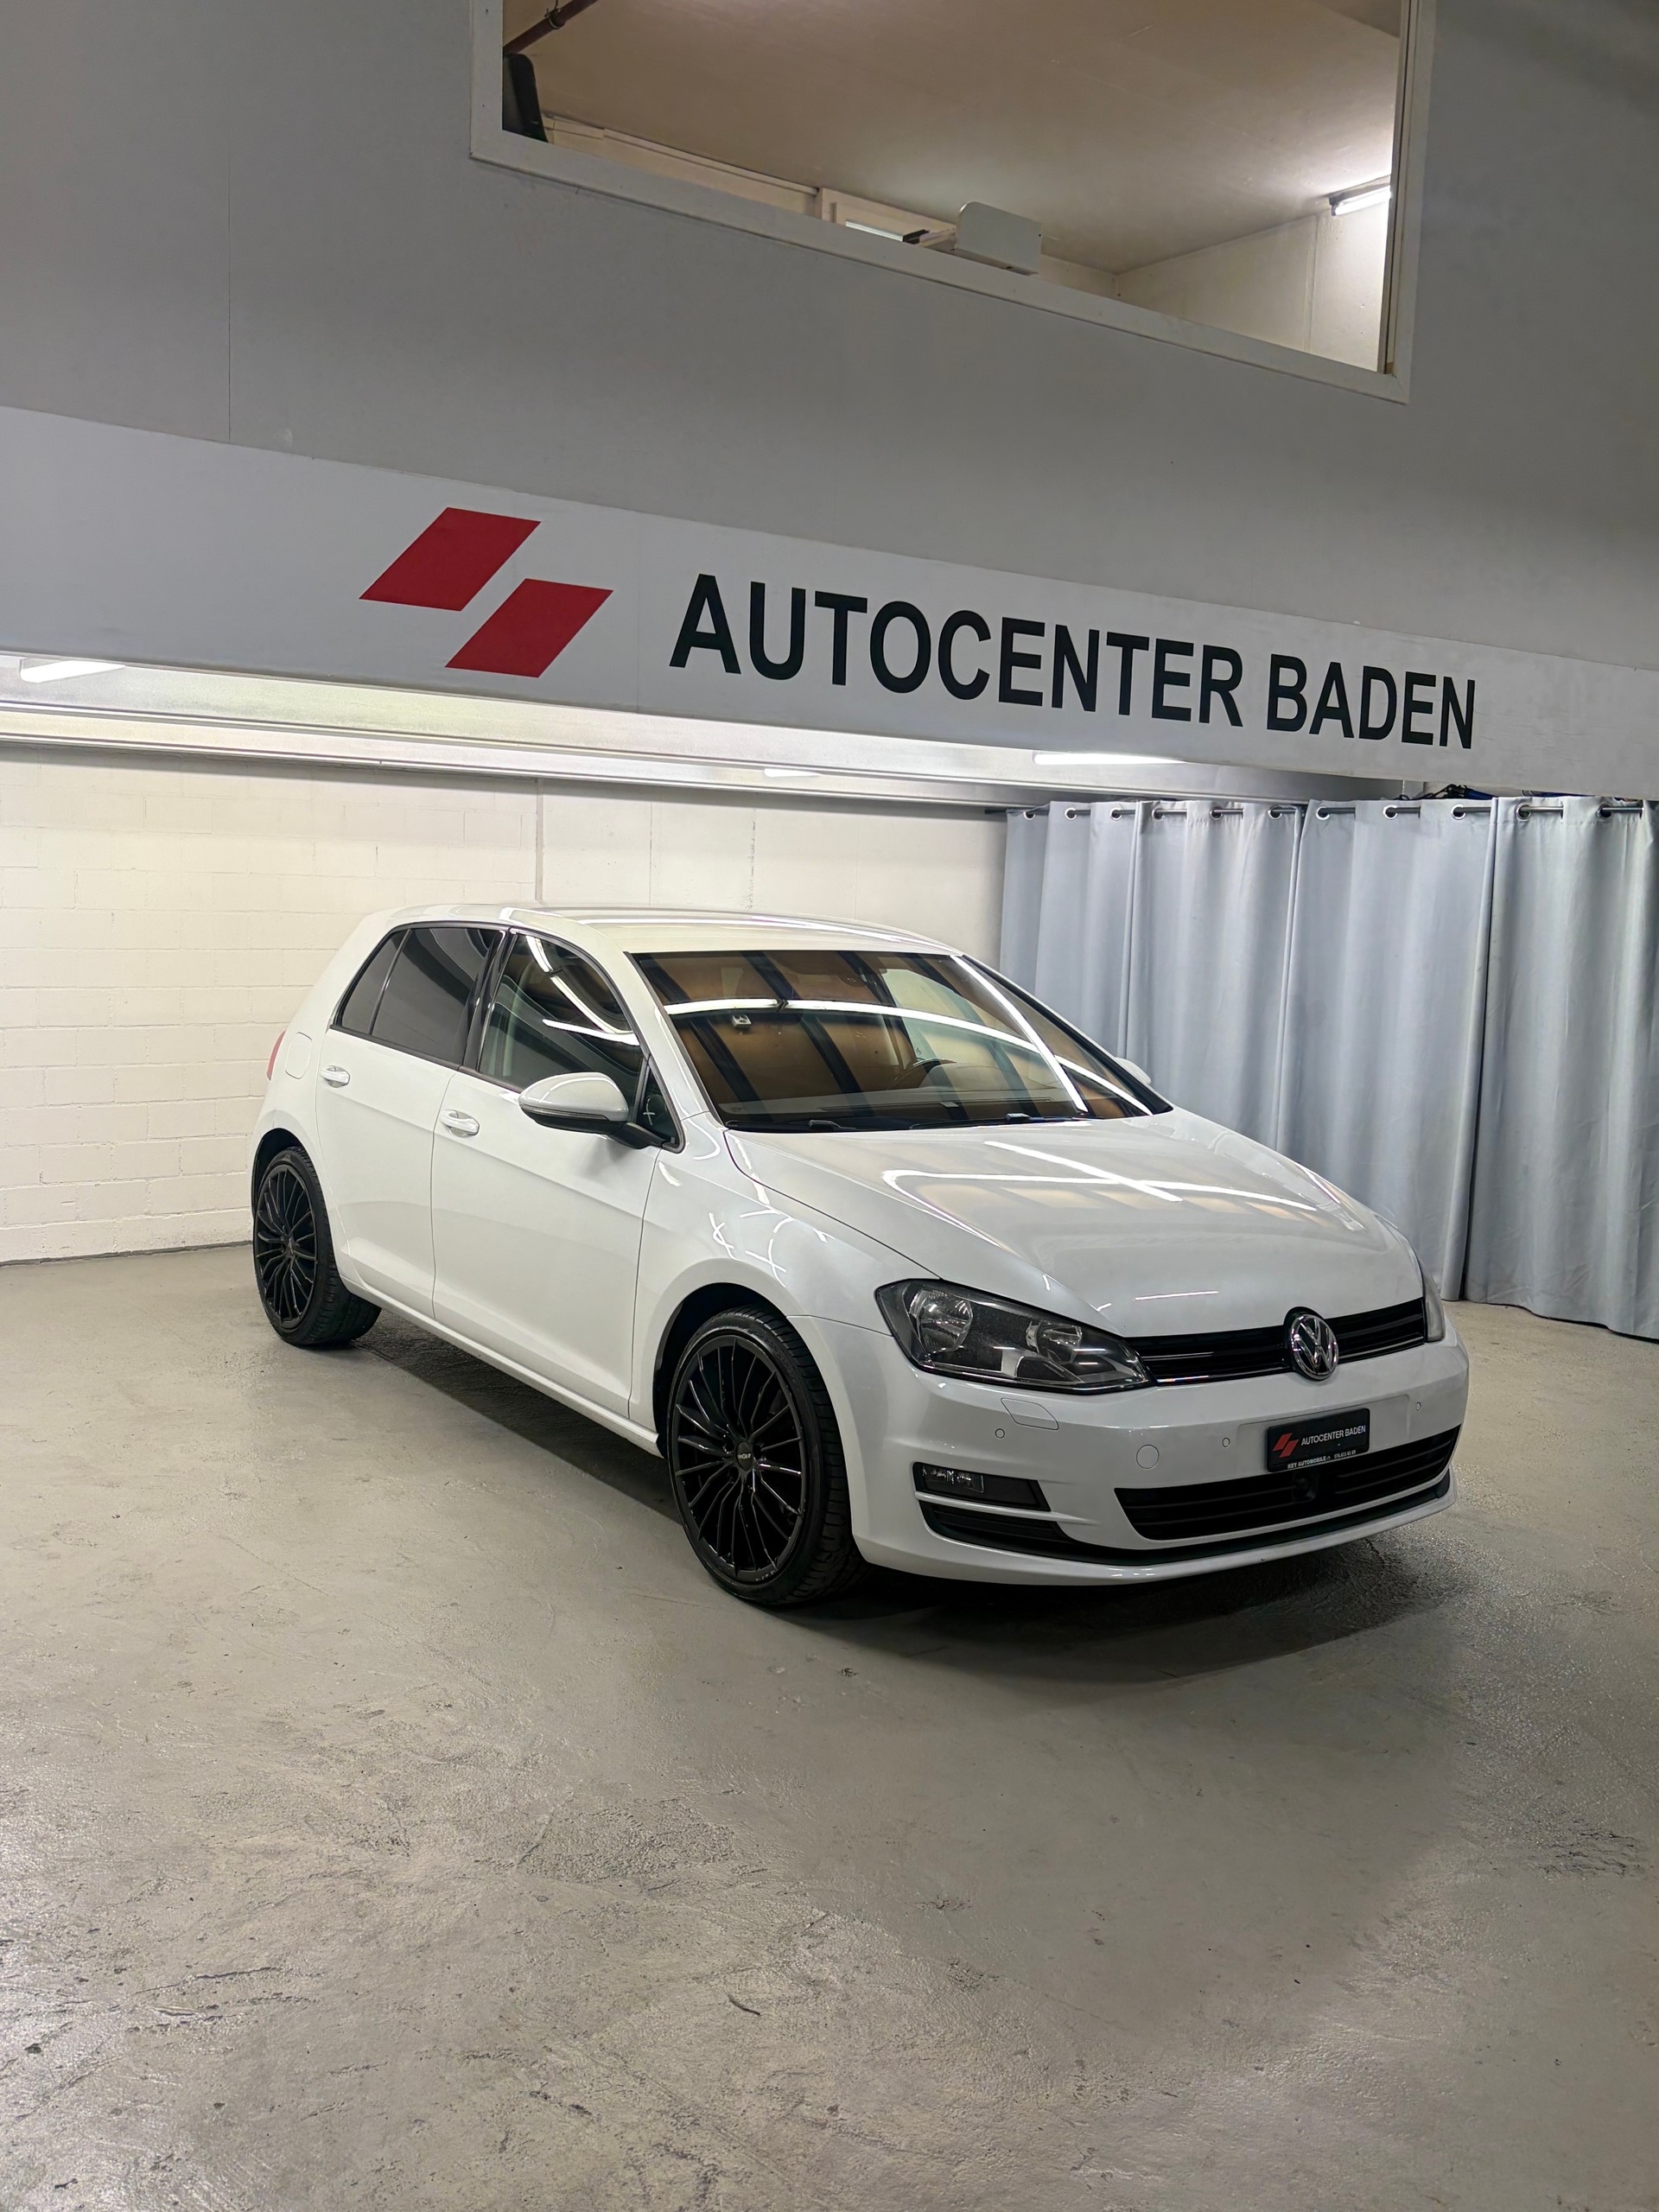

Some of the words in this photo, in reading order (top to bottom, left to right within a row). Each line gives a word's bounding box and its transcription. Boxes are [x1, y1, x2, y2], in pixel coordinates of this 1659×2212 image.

[670, 574, 1243, 727] AUTOCENTER
[1268, 654, 1475, 749] BADEN
[1301, 1430, 1344, 1446] AUTOCENTER
[1344, 1425, 1366, 1437] BADEN
